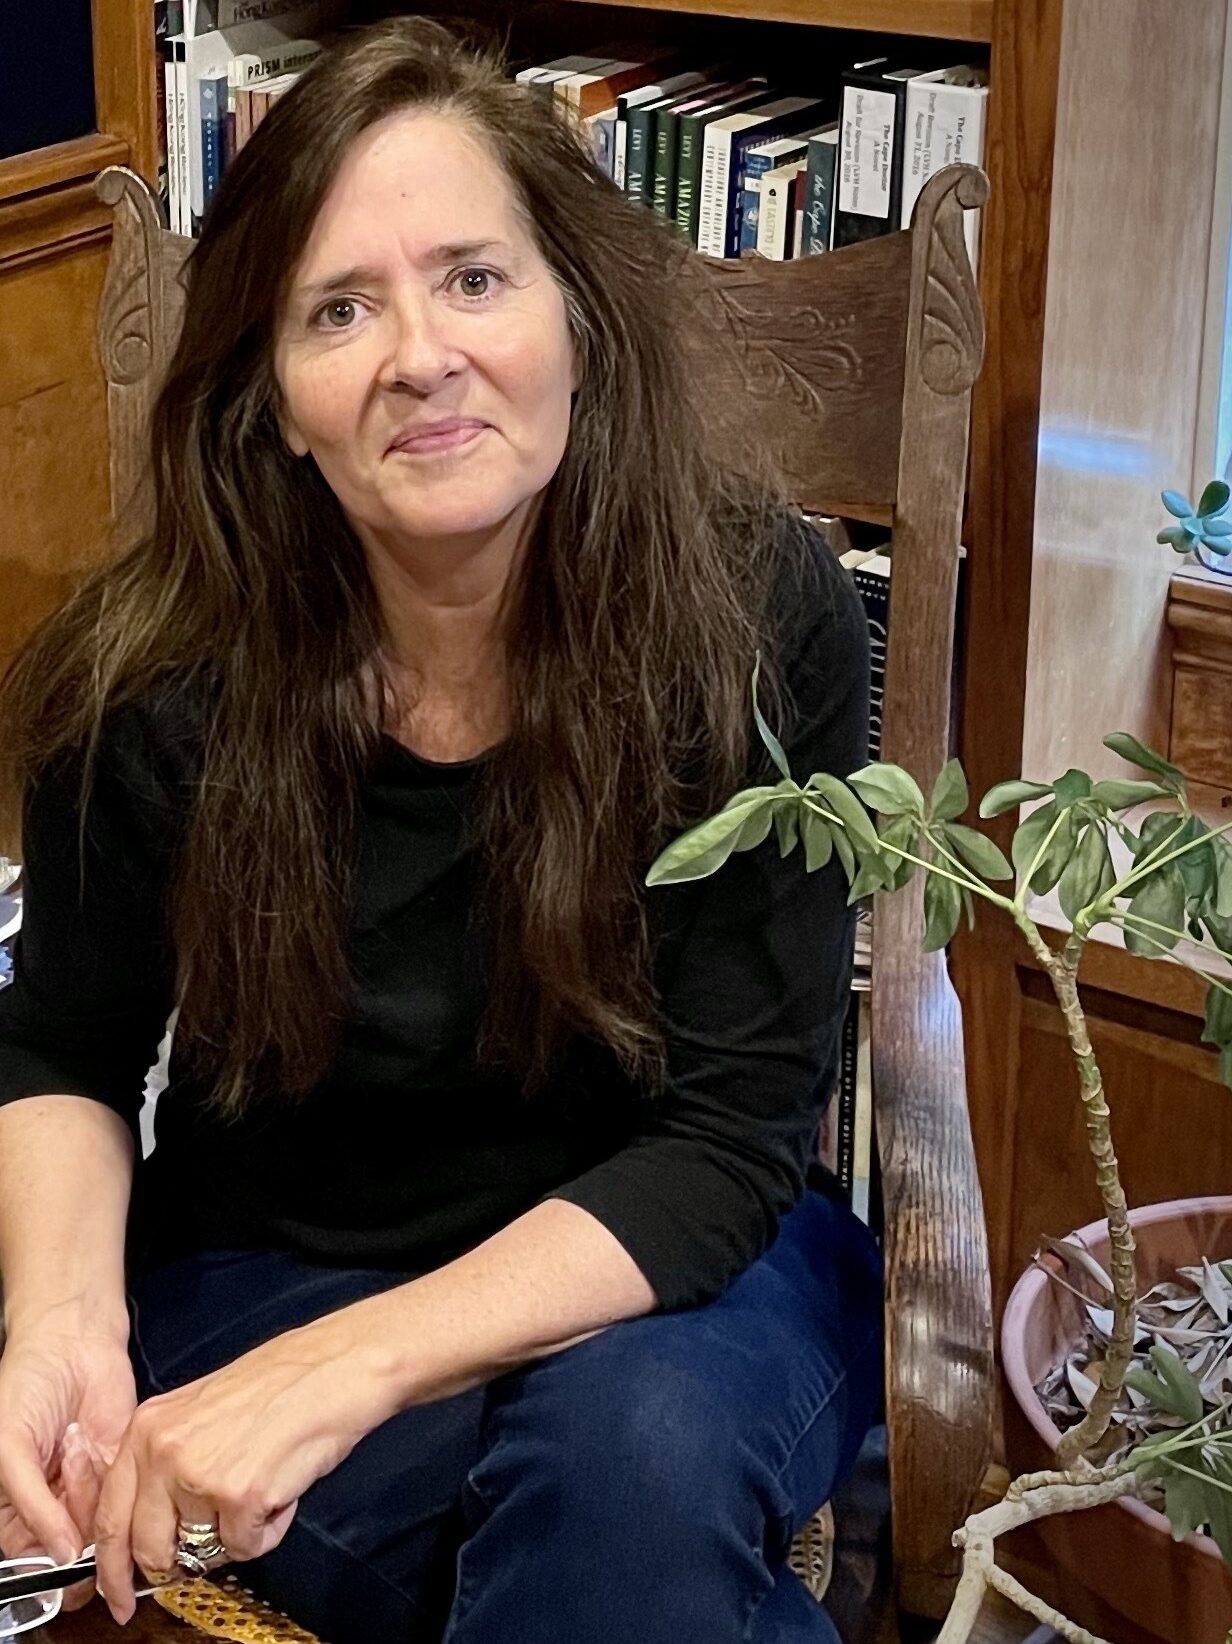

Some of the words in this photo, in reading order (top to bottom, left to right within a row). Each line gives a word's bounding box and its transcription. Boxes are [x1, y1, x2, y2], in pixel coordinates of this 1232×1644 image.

[248, 58, 280, 80] PRISM
[882, 124, 891, 139] The
[957, 117, 966, 131] The
[631, 128, 643, 151] LEVY
[657, 131, 667, 156] LEVY
[681, 135, 693, 158] LEVY
